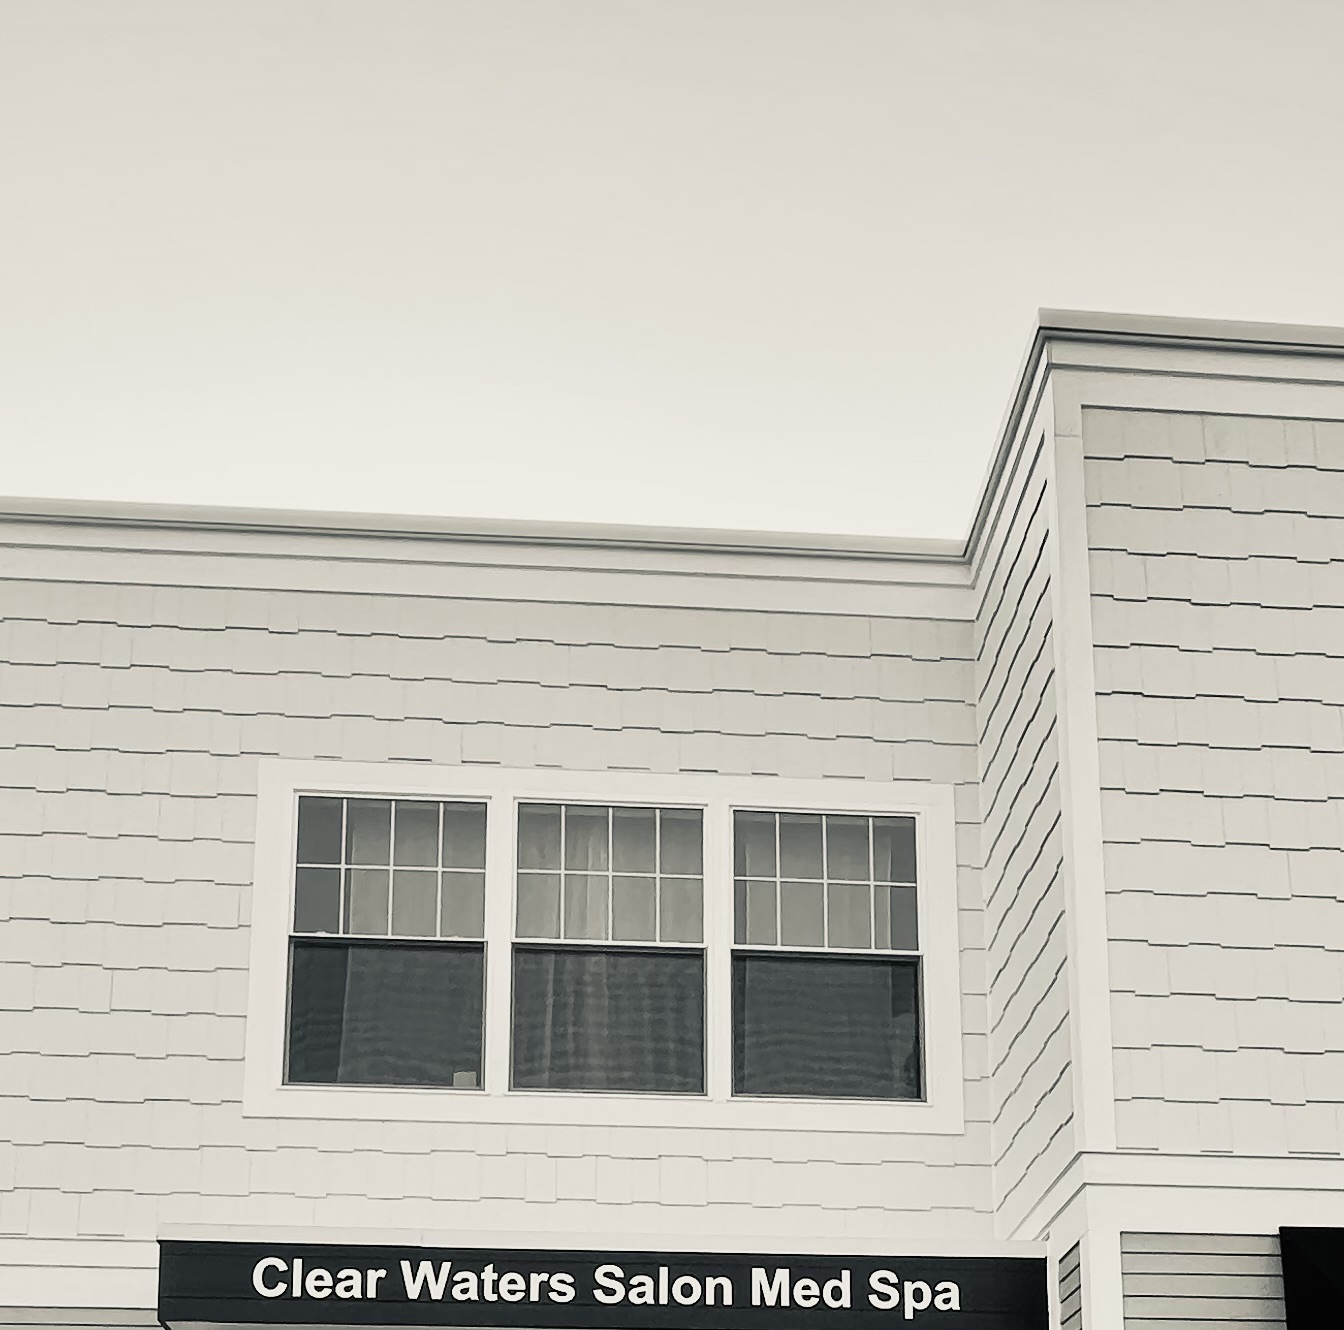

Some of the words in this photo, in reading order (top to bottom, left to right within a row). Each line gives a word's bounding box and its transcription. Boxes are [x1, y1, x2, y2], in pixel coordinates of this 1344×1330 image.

[252, 1256, 388, 1299] Clear
[399, 1260, 576, 1304] Waters
[592, 1264, 733, 1306] Salon
[751, 1267, 852, 1309] Med
[867, 1269, 961, 1320] Spa
